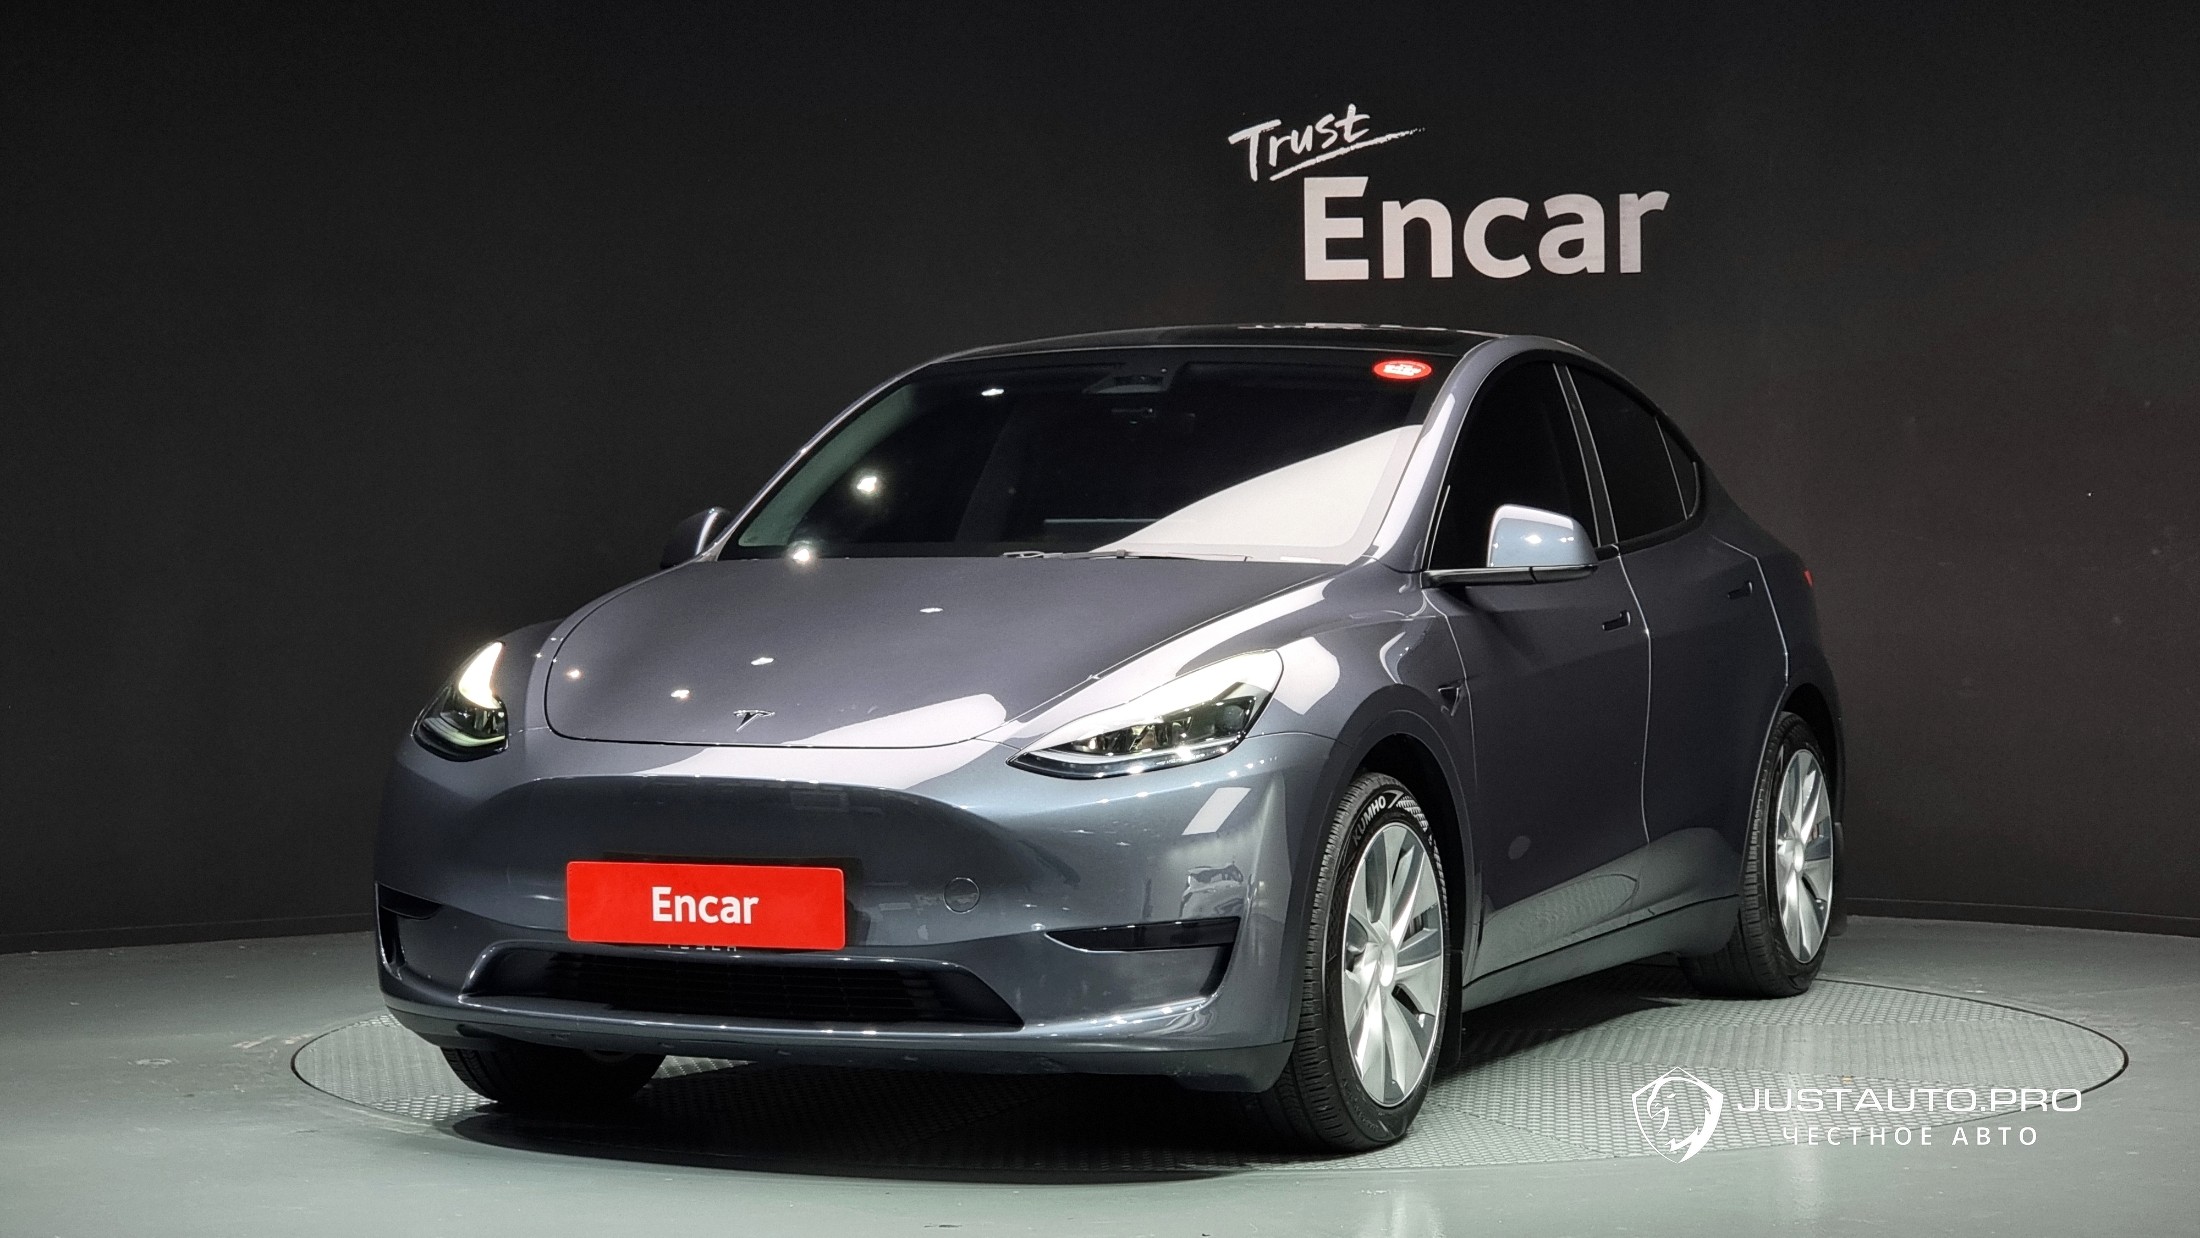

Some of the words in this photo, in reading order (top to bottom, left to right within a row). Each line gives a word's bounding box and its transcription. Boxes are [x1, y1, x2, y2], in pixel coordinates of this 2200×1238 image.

[1227, 103, 1371, 182] Trust
[1303, 175, 1671, 281] Encar
[1351, 795, 1387, 847] KUMHO
[651, 886, 760, 925] Encar
